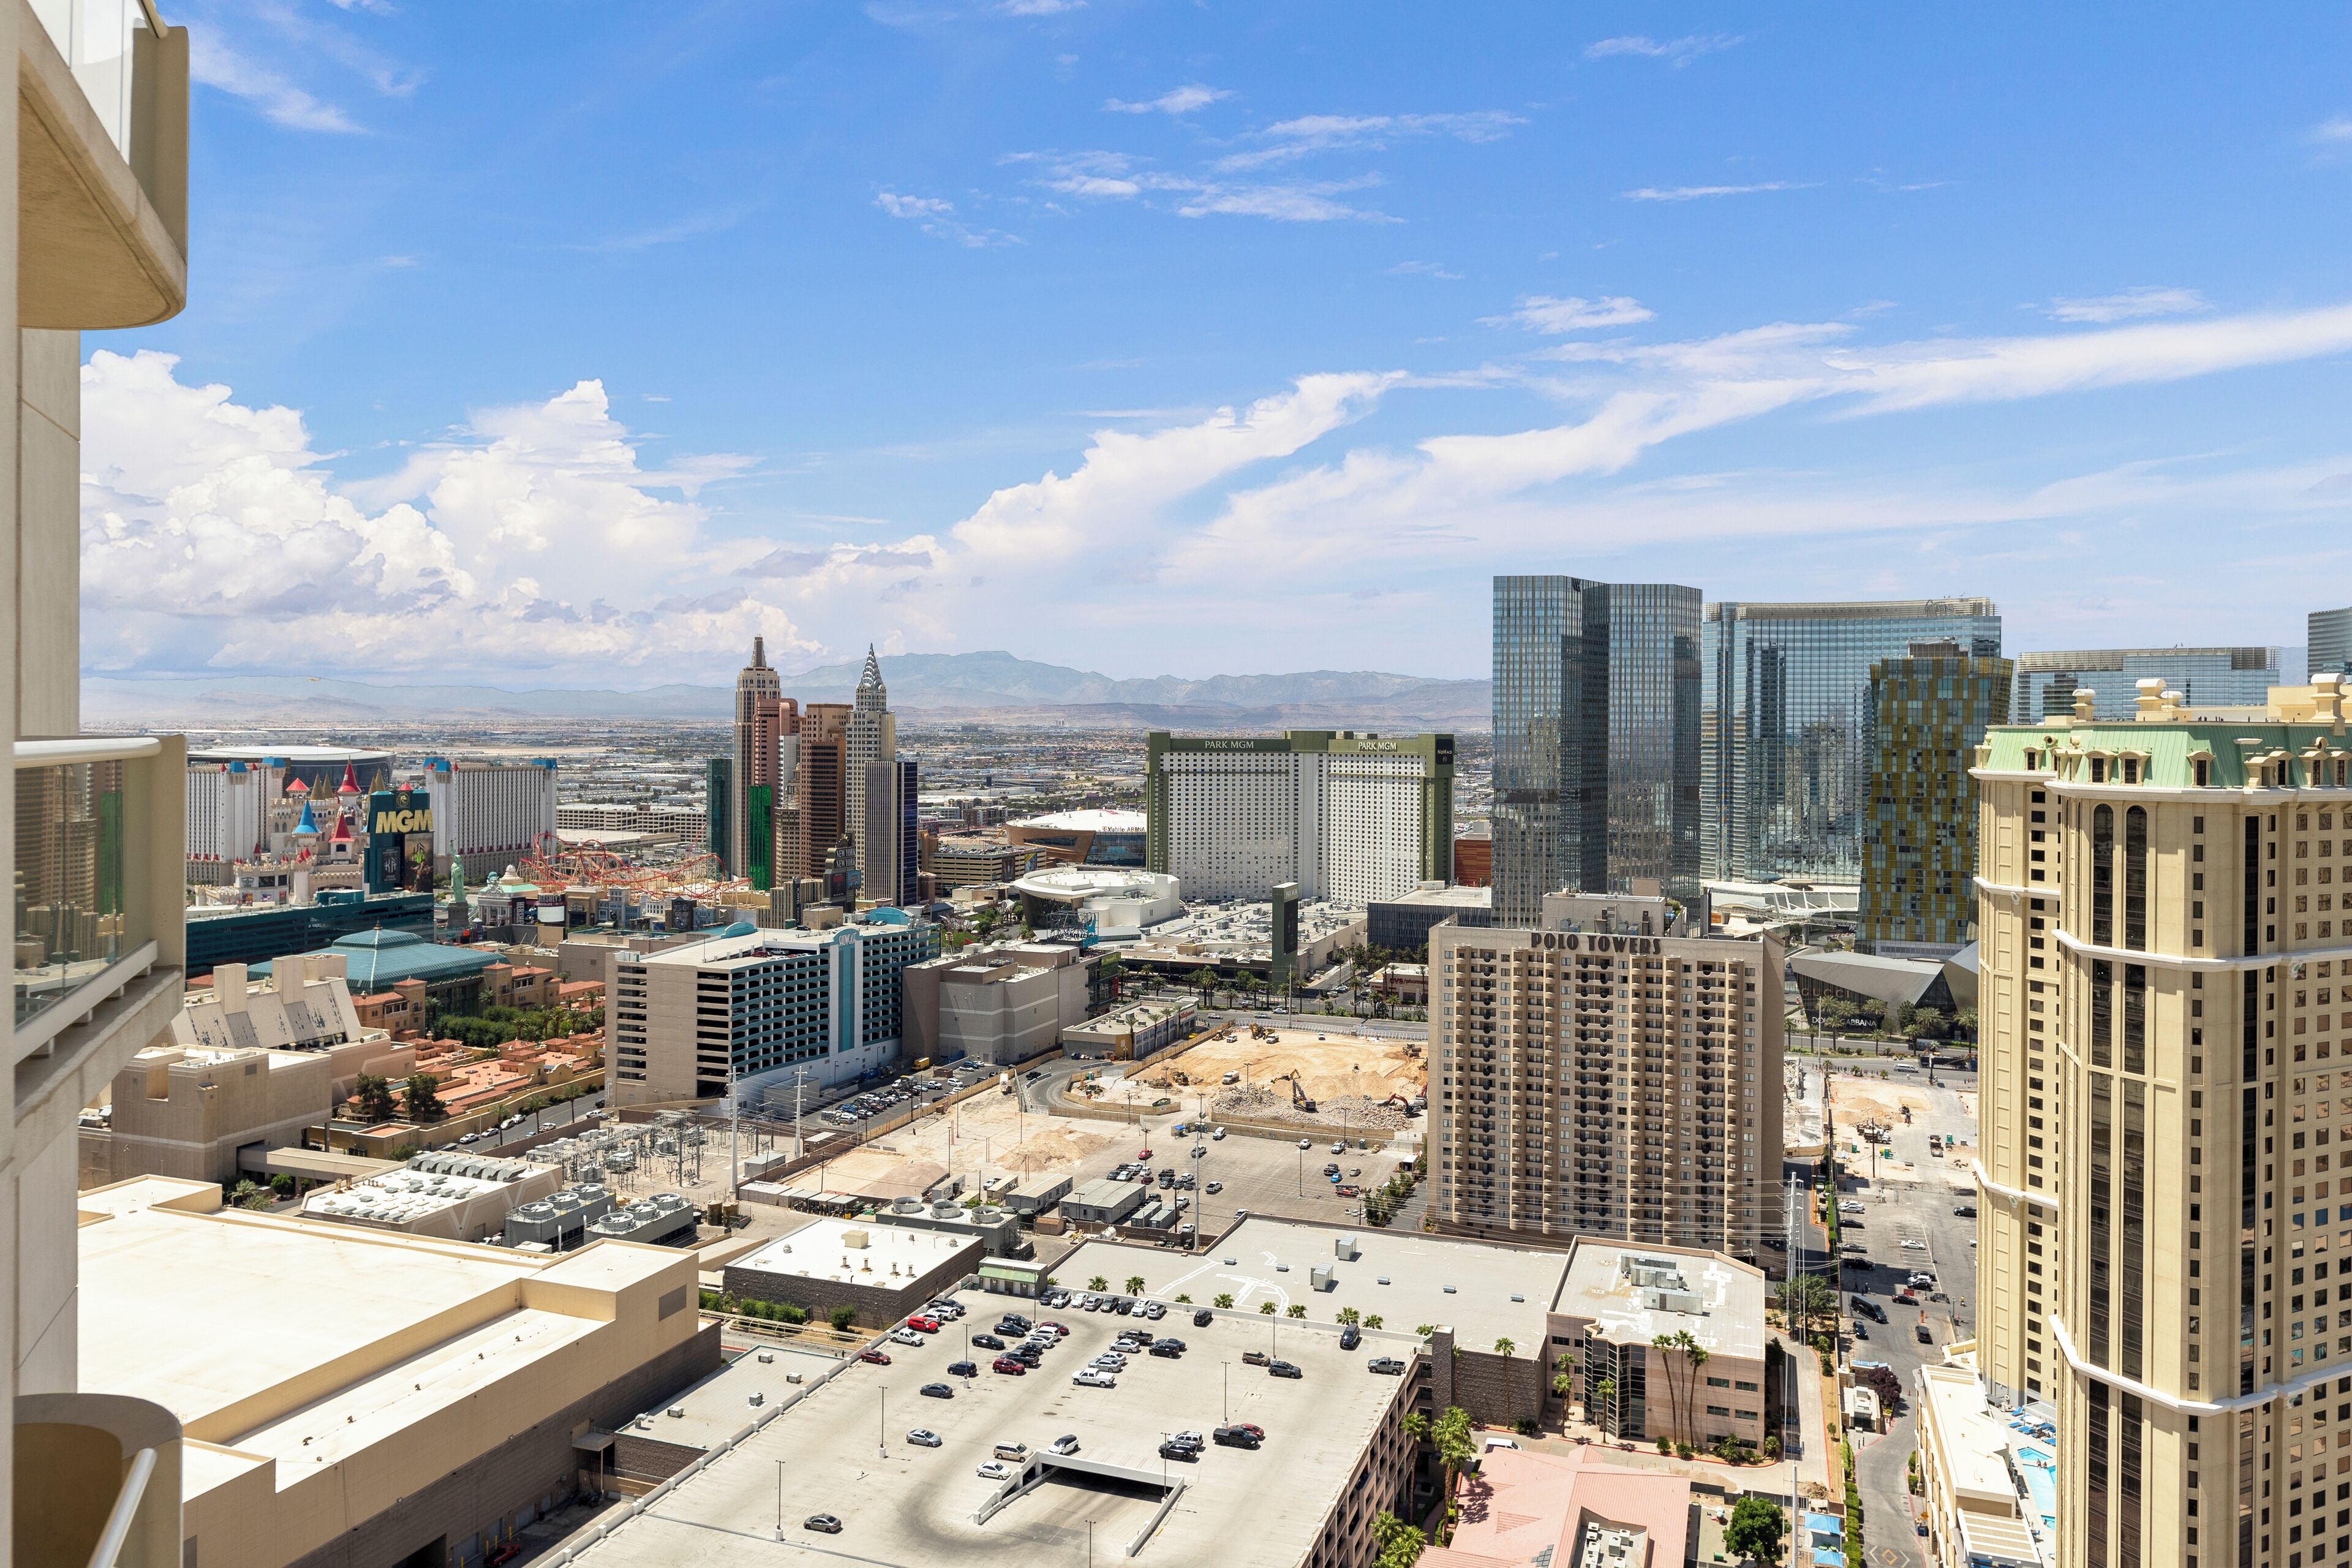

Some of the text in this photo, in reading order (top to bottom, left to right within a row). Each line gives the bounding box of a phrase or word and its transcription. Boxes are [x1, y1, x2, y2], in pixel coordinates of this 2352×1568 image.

[1358, 742, 1397, 751] PARK MGM
[375, 809, 434, 834] MGM
[845, 848, 856, 856] YORK
[836, 858, 856, 868] NEW YORK
[839, 932, 856, 947] SHOWCASE
[1531, 932, 1660, 954] POLO TOWERS
[1801, 988, 1850, 998] GUCCI
